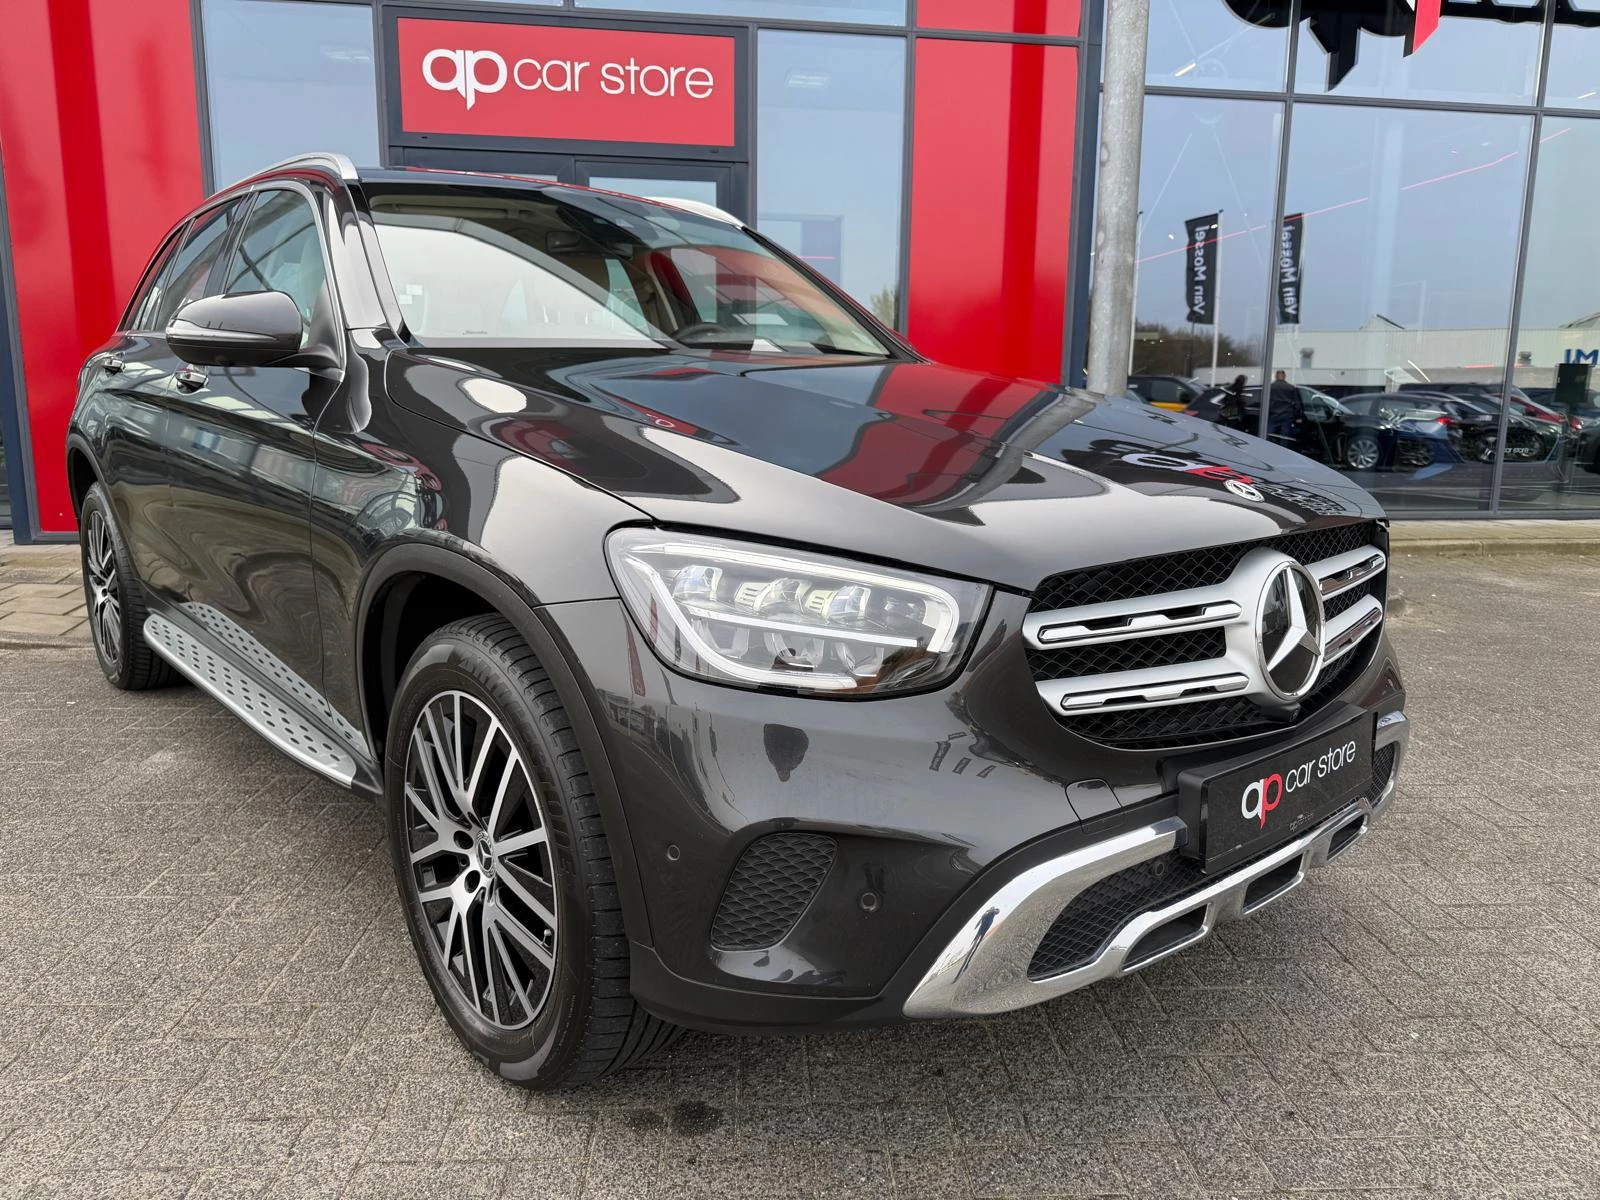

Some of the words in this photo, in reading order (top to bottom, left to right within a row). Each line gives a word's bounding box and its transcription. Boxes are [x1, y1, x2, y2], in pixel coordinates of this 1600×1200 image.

[421, 48, 508, 111] ap
[513, 58, 590, 92] car
[600, 57, 714, 99] store
[1240, 773, 1283, 830] ap
[1285, 760, 1315, 793] car
[1317, 740, 1356, 778] store
